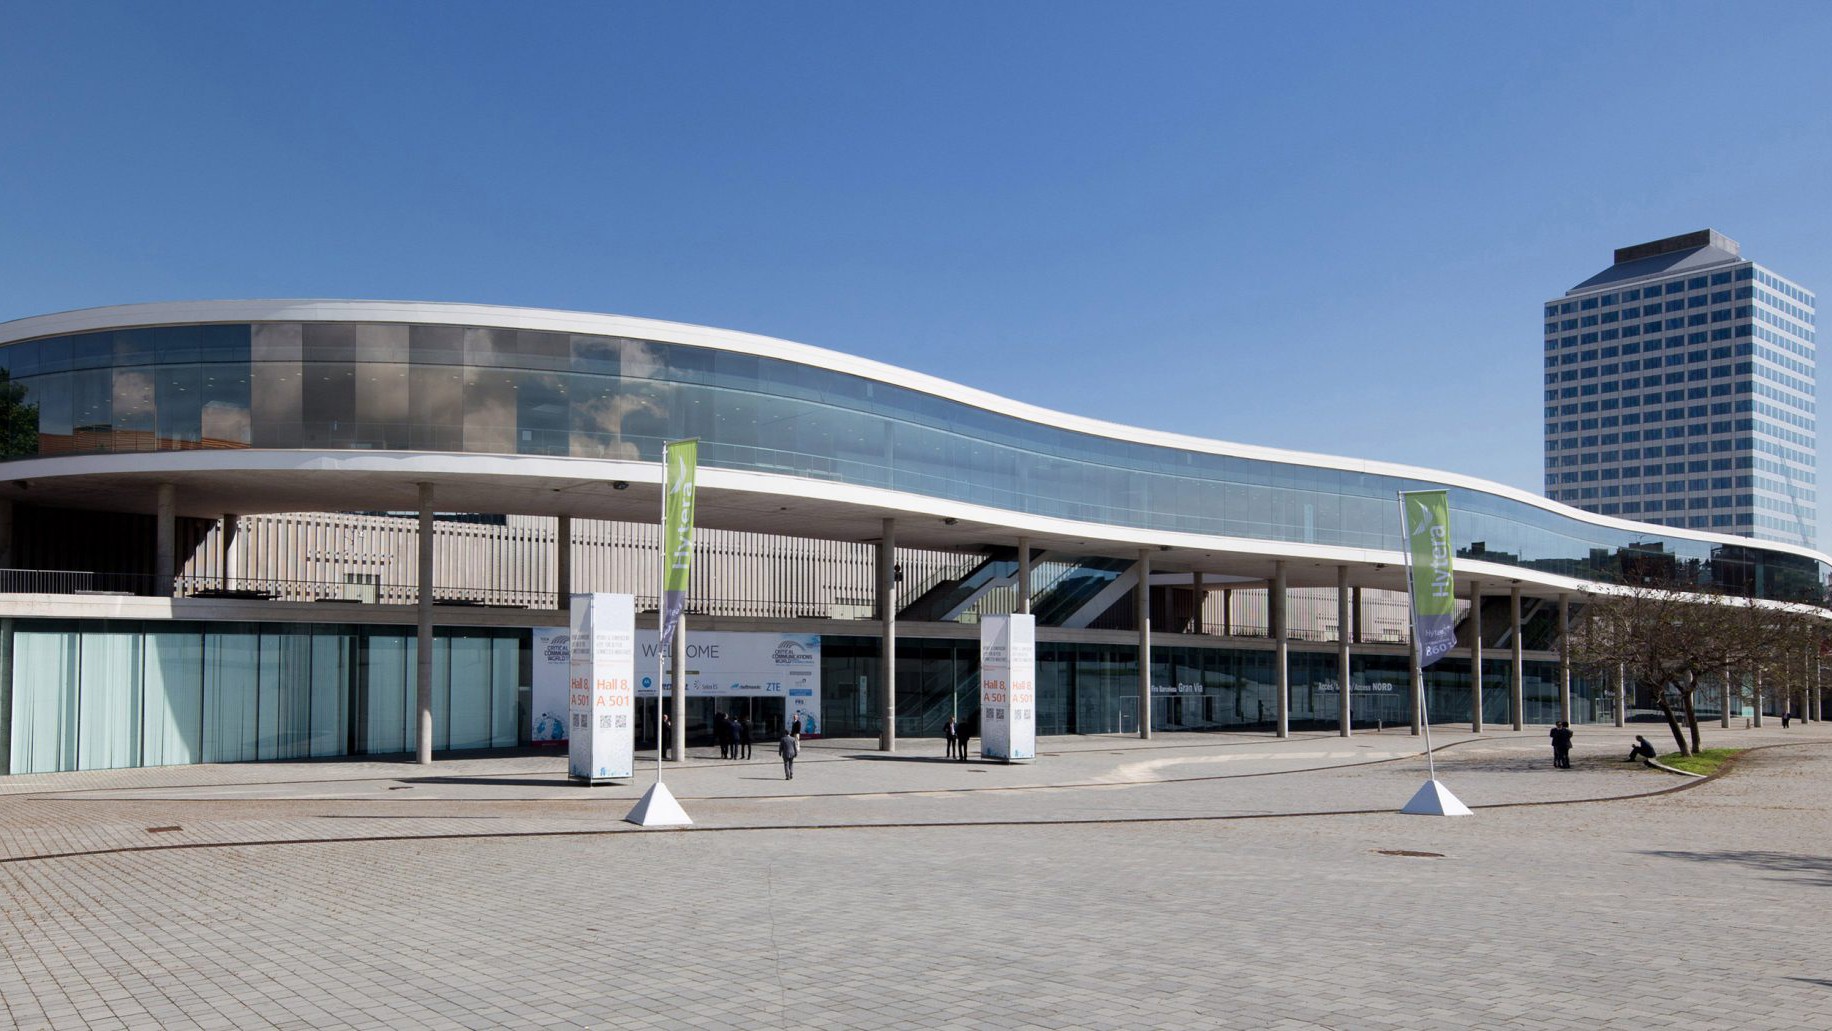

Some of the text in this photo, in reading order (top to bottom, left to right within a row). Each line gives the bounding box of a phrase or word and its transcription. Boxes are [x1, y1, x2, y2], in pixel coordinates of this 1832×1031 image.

[672, 481, 692, 569] Hytera
[1430, 525, 1450, 598] Hytera
[641, 643, 719, 658] WELOME
[571, 677, 590, 692] Hall 8,
[597, 678, 630, 692] Hall 8,
[766, 682, 781, 691] ZTE
[983, 680, 1006, 691] Hall 8,
[1012, 681, 1033, 691] Hall 8,
[1178, 683, 1192, 693] Gran
[1193, 683, 1203, 693] Via
[1372, 682, 1393, 691] NORD
[571, 694, 589, 706] A 501
[596, 695, 629, 707] A 501
[983, 692, 1006, 703] A 501
[1012, 694, 1033, 703] A 501
